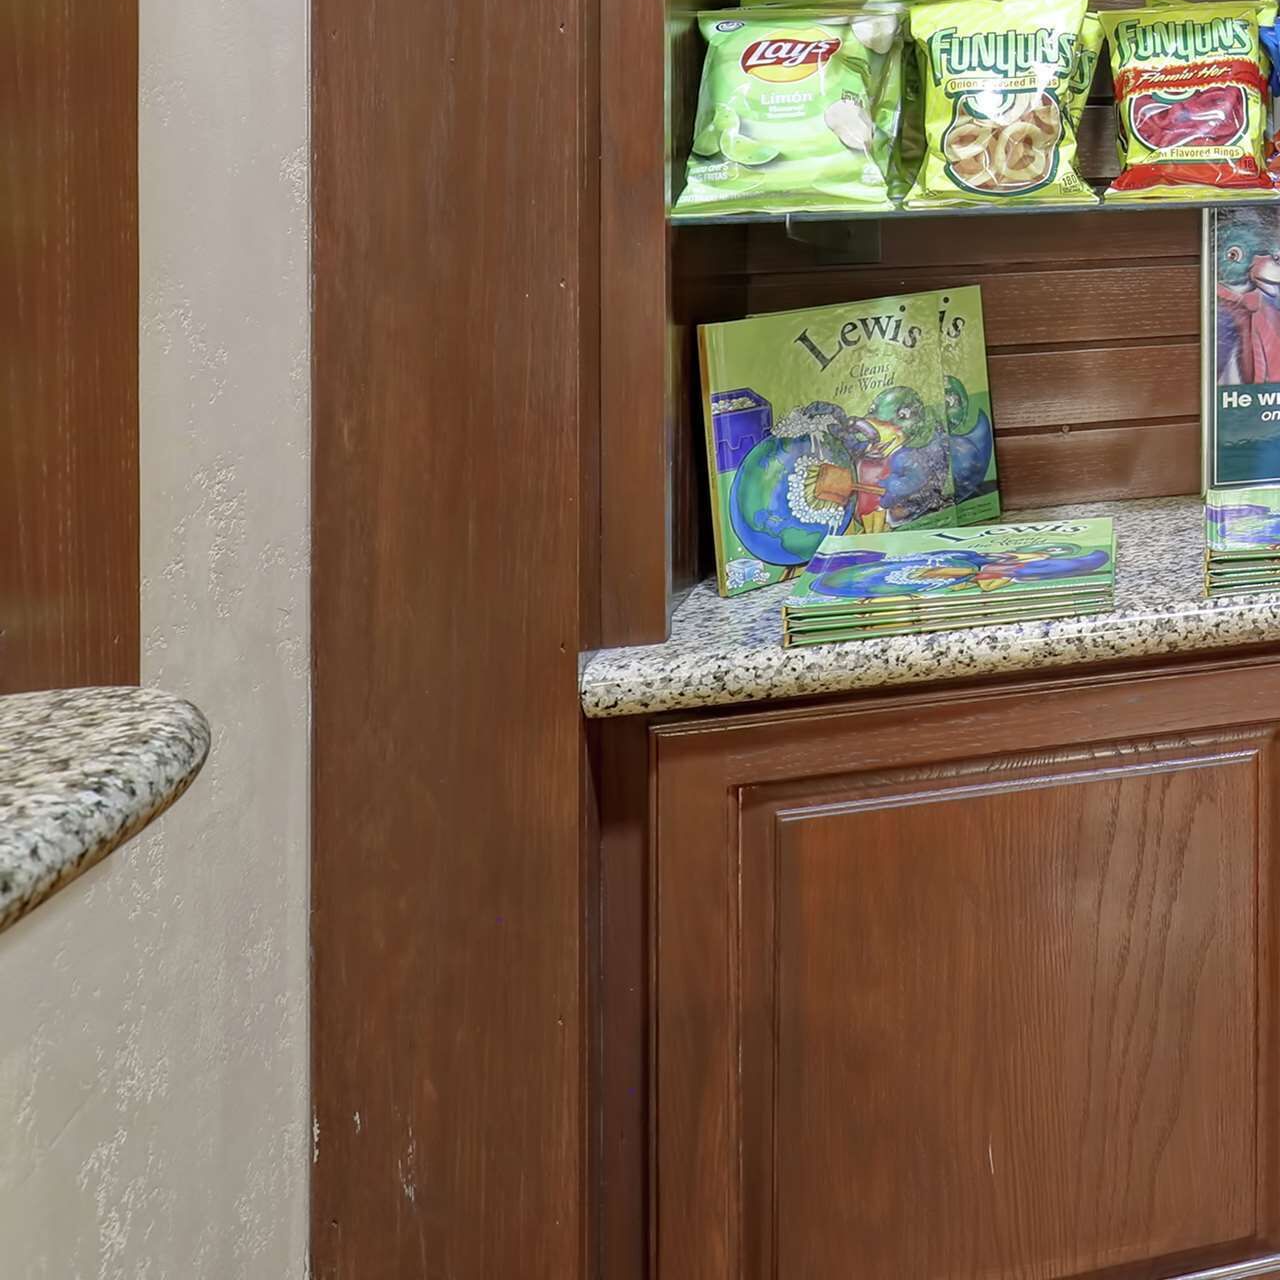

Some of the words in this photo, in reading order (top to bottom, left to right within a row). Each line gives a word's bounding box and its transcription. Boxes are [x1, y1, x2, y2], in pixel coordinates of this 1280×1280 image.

[1118, 19, 1252, 66] FUNYUNS
[747, 39, 841, 66] Lay's
[928, 27, 1076, 88] FUNYUNS
[950, 78, 978, 90] Onion
[1140, 67, 1199, 85] Flamin'
[1201, 65, 1232, 82] Hot
[761, 91, 812, 105] Limón
[1170, 147, 1211, 158] Flavored
[794, 305, 922, 372] Lewis
[849, 363, 890, 378] Cleans
[858, 374, 895, 391] World
[1222, 392, 1252, 408] He
[929, 522, 1088, 545] Lewis
